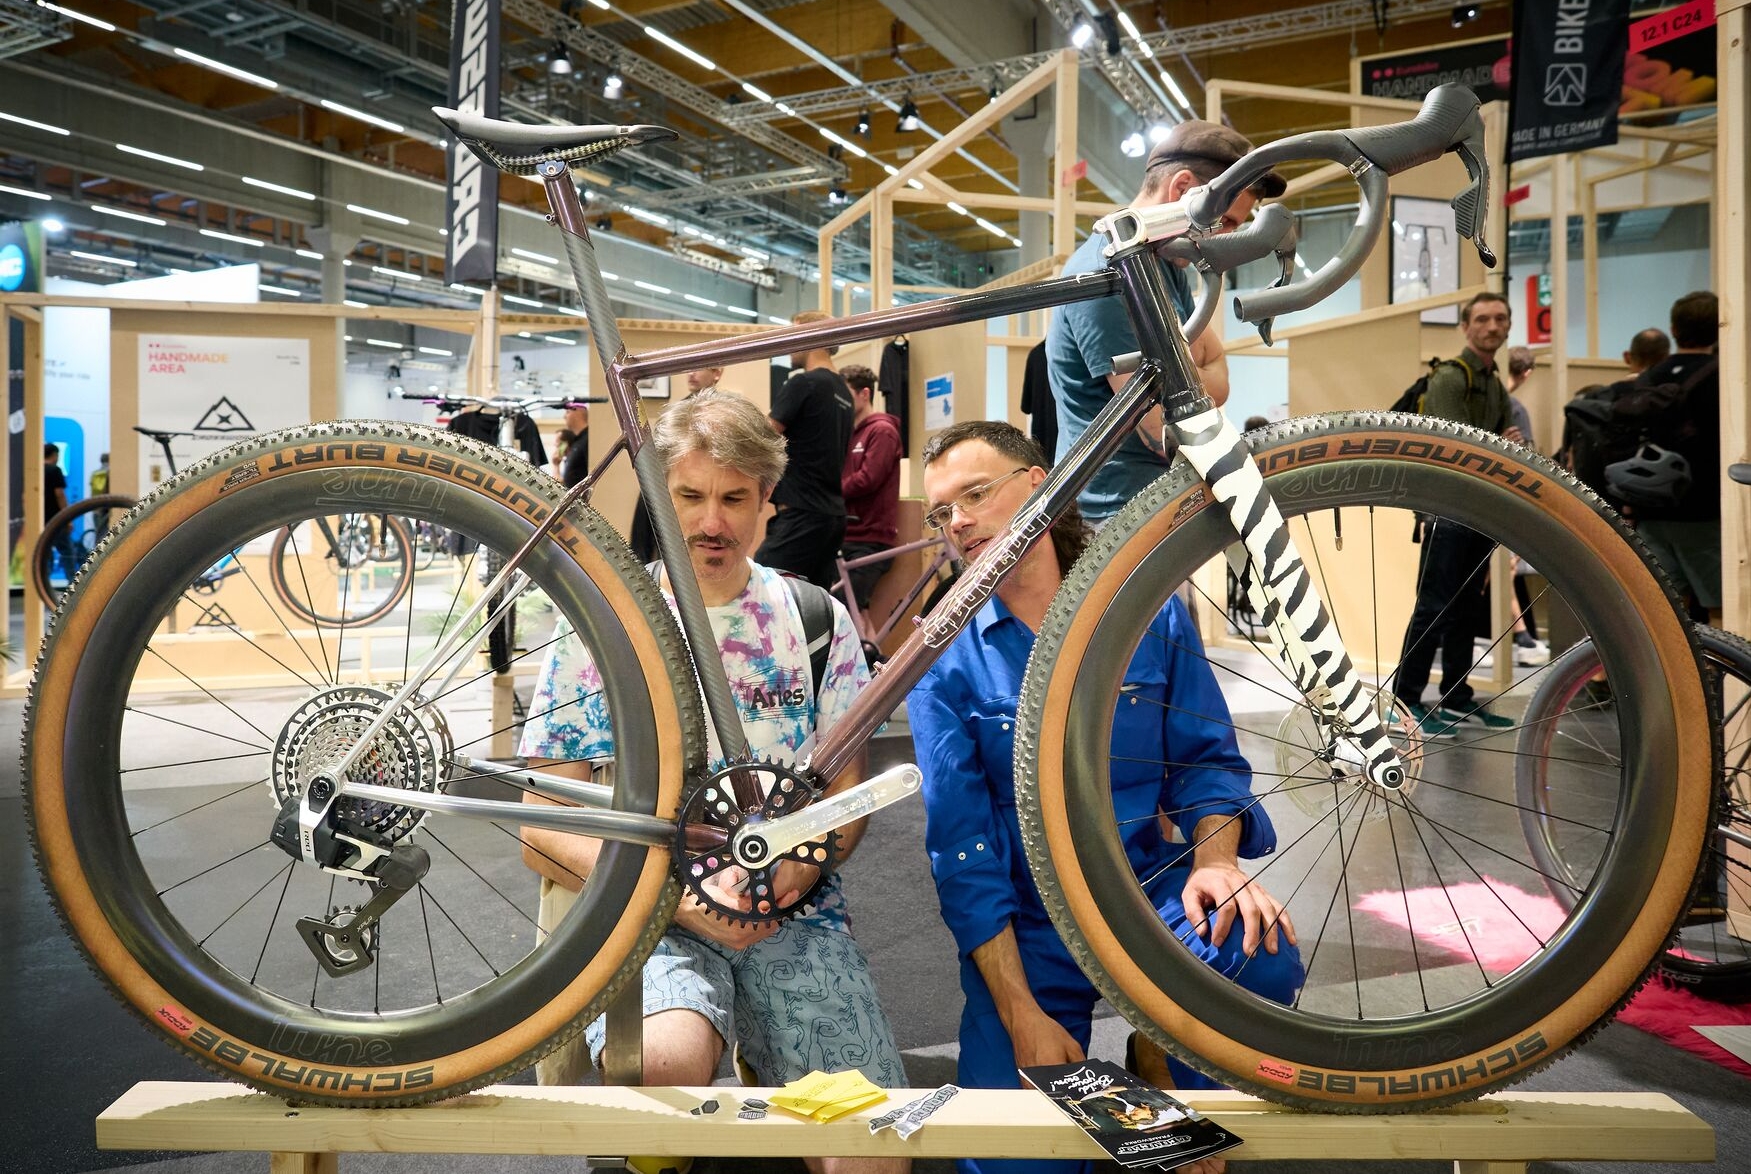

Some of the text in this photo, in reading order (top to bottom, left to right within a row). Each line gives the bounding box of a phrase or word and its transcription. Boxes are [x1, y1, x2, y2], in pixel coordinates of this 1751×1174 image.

[1553, 0, 1592, 54] BIKE
[1641, 9, 1702, 43] 12.1 C24
[1539, 124, 1552, 139] IN
[1553, 117, 1607, 137] GERMANY
[148, 352, 230, 364] HANDMADE
[148, 363, 185, 374] AREA
[1338, 438, 1544, 499] THUNDER
[267, 443, 578, 554] THUNDER BURT
[749, 683, 805, 711] Aries
[1661, 971, 1702, 985] CONT
[190, 1026, 435, 1092] SCHWALBE
[1297, 1031, 1550, 1096] SCHWALBE
[1049, 1074, 1080, 1092] own!
[1067, 1069, 1096, 1090] your
[1078, 1073, 1114, 1095] Build
